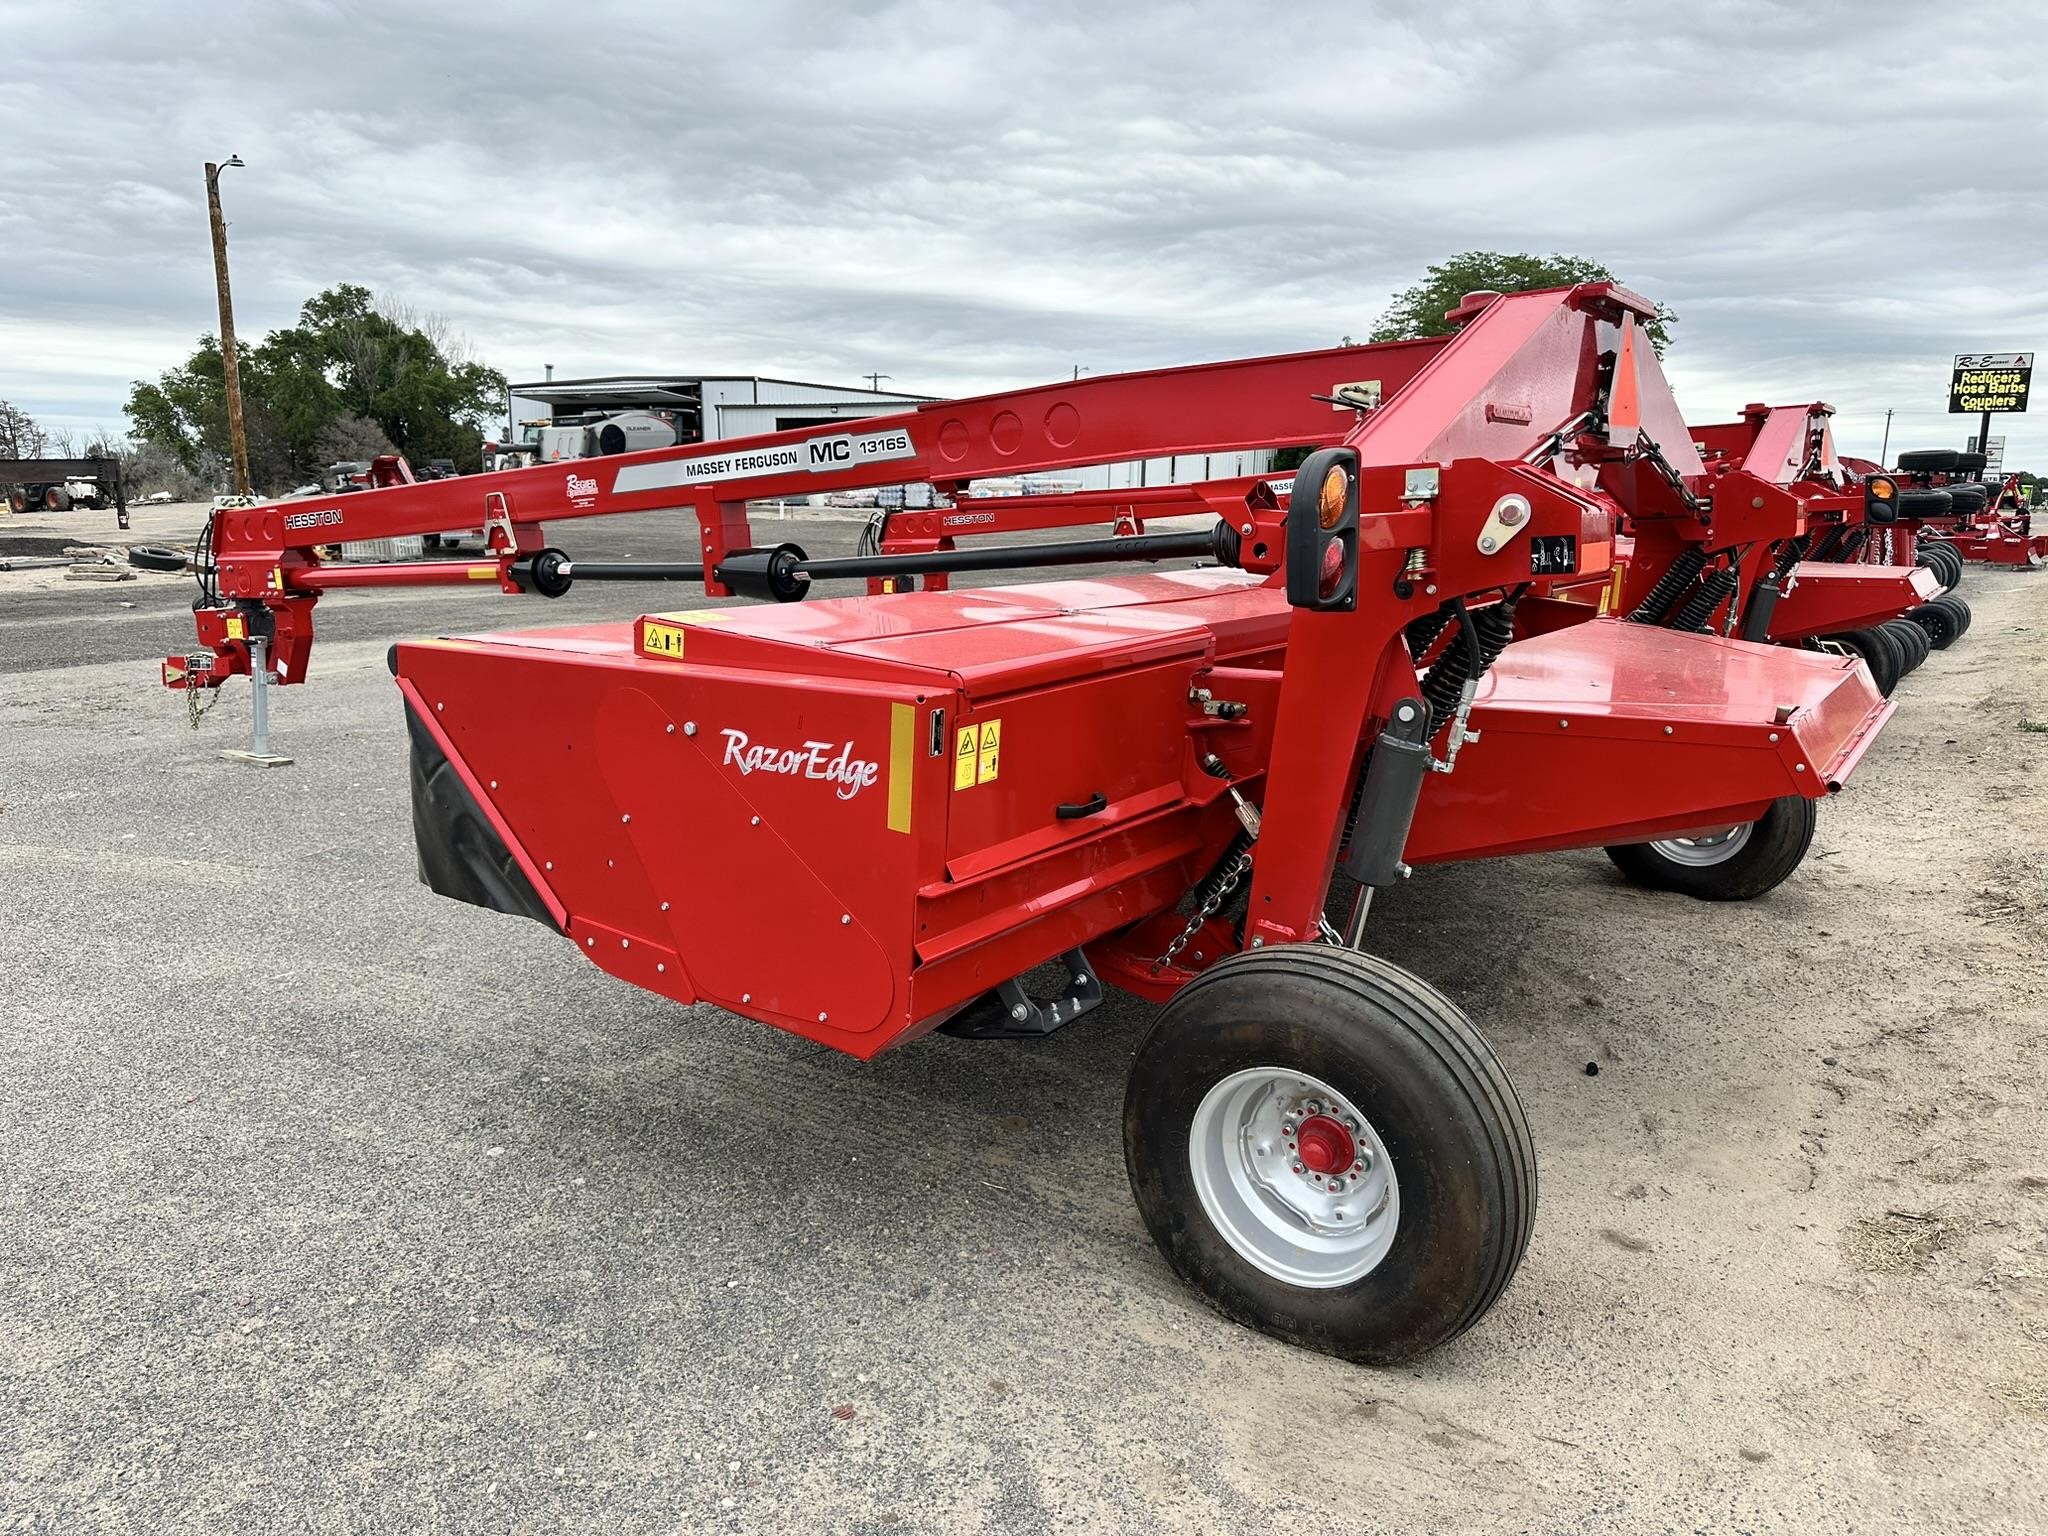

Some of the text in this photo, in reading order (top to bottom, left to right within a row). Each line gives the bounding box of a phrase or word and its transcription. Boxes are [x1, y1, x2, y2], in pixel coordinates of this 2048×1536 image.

[1961, 371, 2021, 384] Reducers
[1953, 382, 2026, 394] Hose Barbs
[1960, 395, 2017, 408] Couplers
[685, 436, 907, 477] MASSEY FERGUSON MC 1316S
[284, 509, 343, 530] HESSTON
[943, 513, 995, 526] HESSTON
[720, 728, 879, 800] RazorEdge
